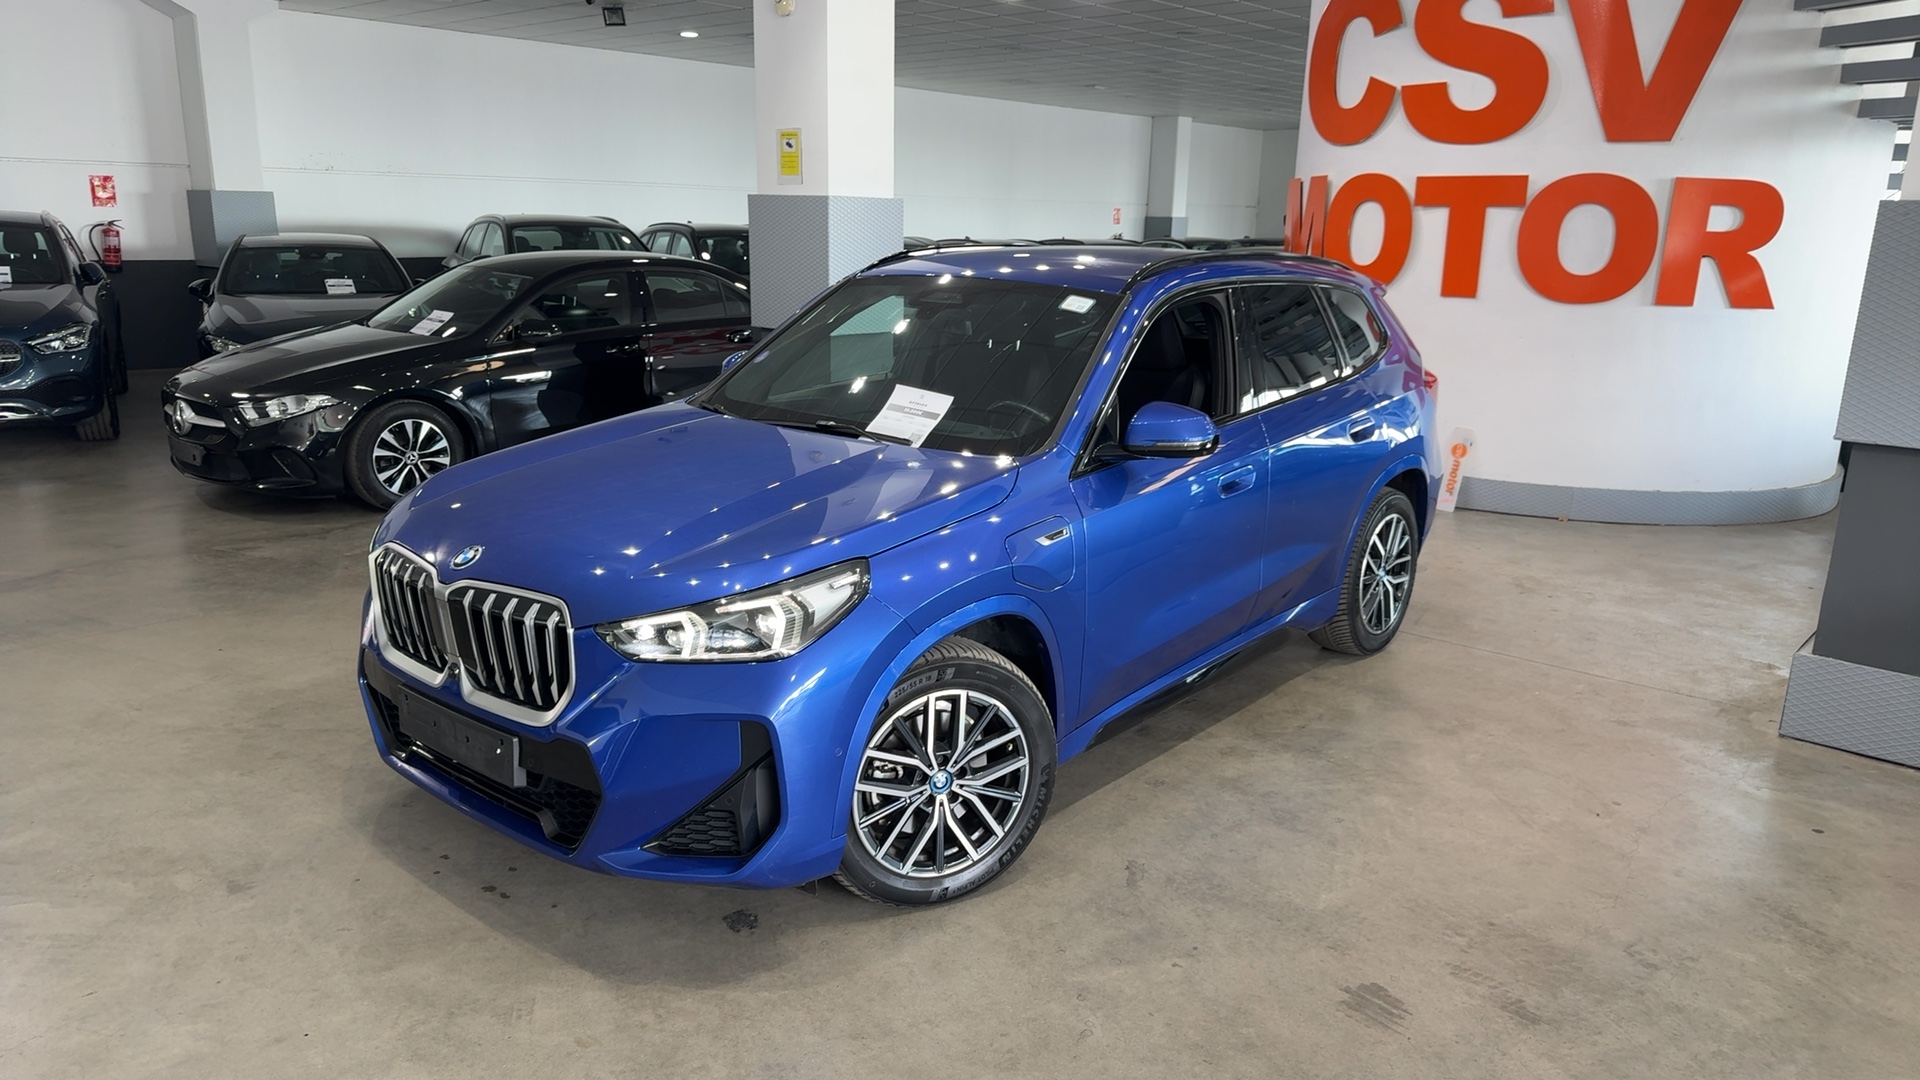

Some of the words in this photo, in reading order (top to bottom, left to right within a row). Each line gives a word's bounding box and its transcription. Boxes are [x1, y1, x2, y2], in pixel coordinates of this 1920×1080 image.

[1308, 0, 1743, 146] CSV
[1283, 172, 1785, 310] MOTOR
[978, 867, 996, 882] PILOT
[1002, 787, 1047, 864] MICHELIN
